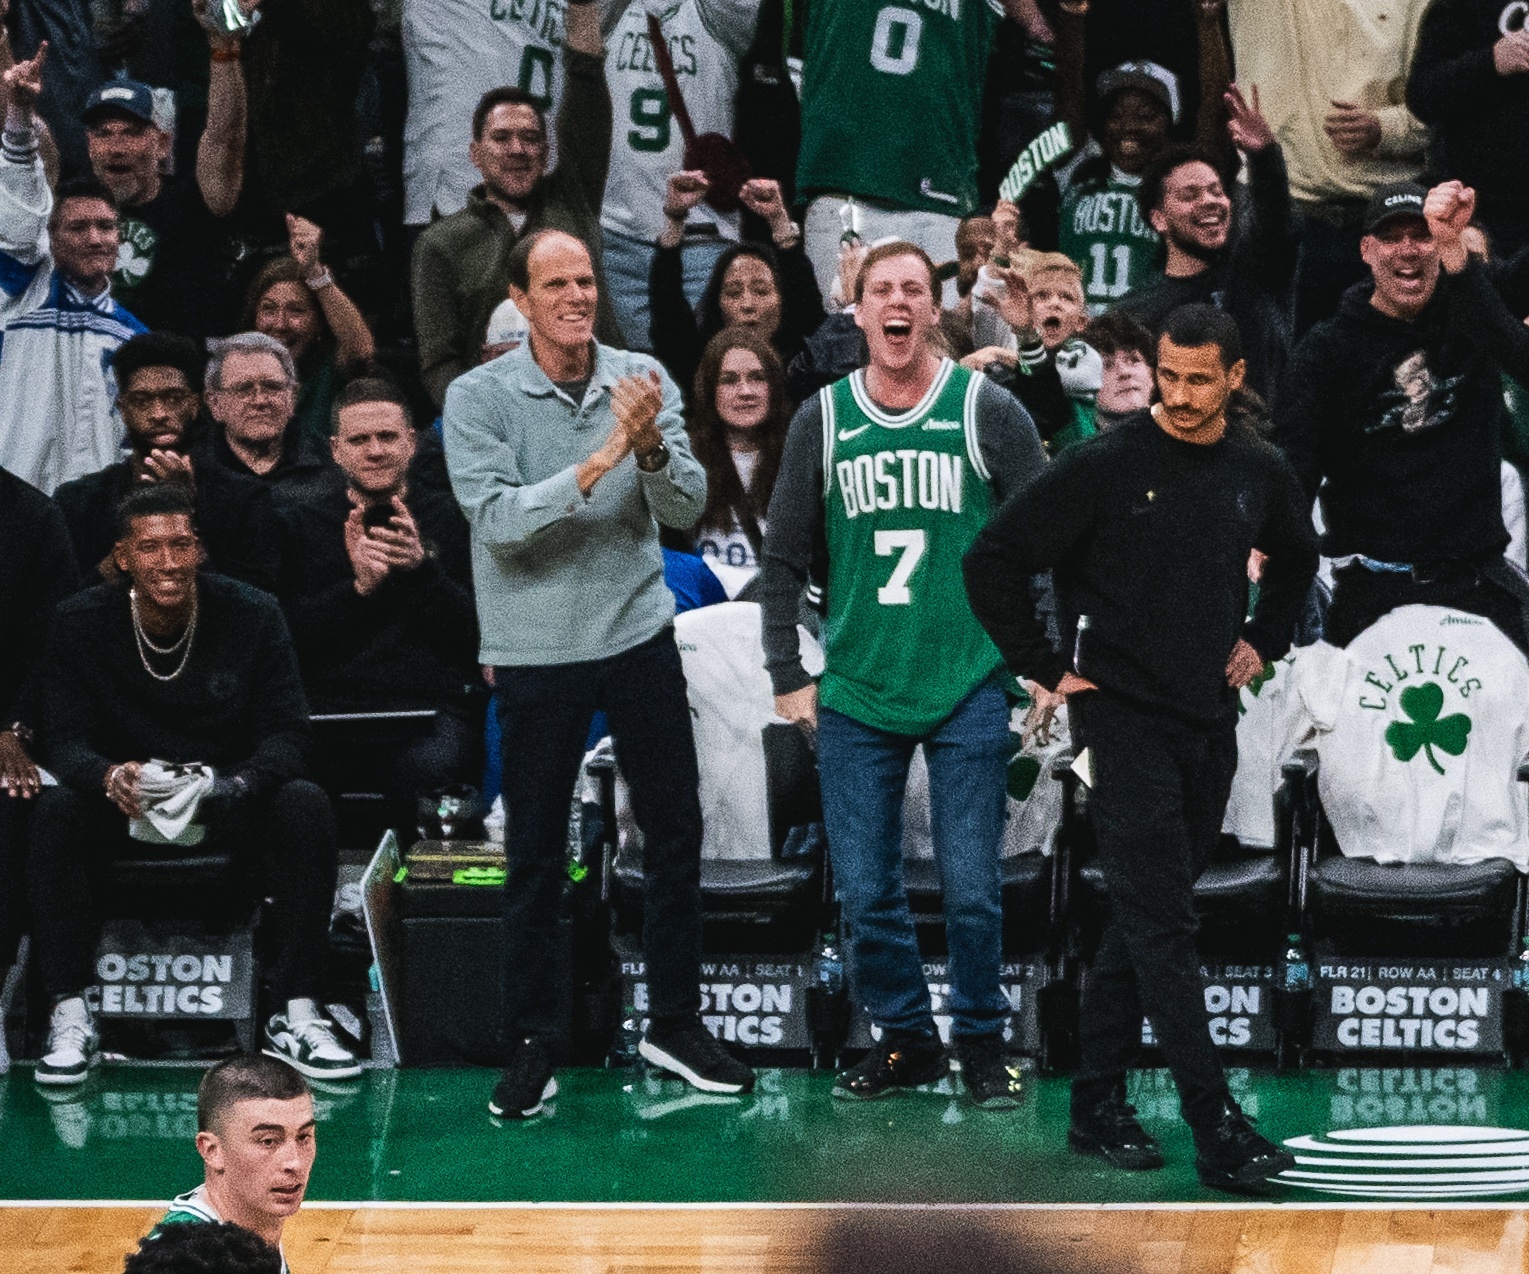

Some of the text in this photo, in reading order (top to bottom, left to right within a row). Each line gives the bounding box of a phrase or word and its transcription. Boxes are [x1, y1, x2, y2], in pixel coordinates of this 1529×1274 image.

[869, 6, 923, 75] 0
[627, 86, 672, 152] 9
[1087, 243, 1132, 298] 11
[832, 449, 962, 519] BOSTON
[873, 528, 926, 606] 7
[1358, 643, 1482, 710] CELTICS
[97, 953, 233, 983] OSTON
[1319, 965, 1348, 979] FLR
[1378, 966, 1412, 980] ROW
[1416, 967, 1437, 980] AA
[1452, 967, 1489, 981] SEAT
[633, 982, 792, 1013] BTON
[1331, 985, 1489, 1017] BOSTON
[1337, 1017, 1480, 1048] CELTICS
